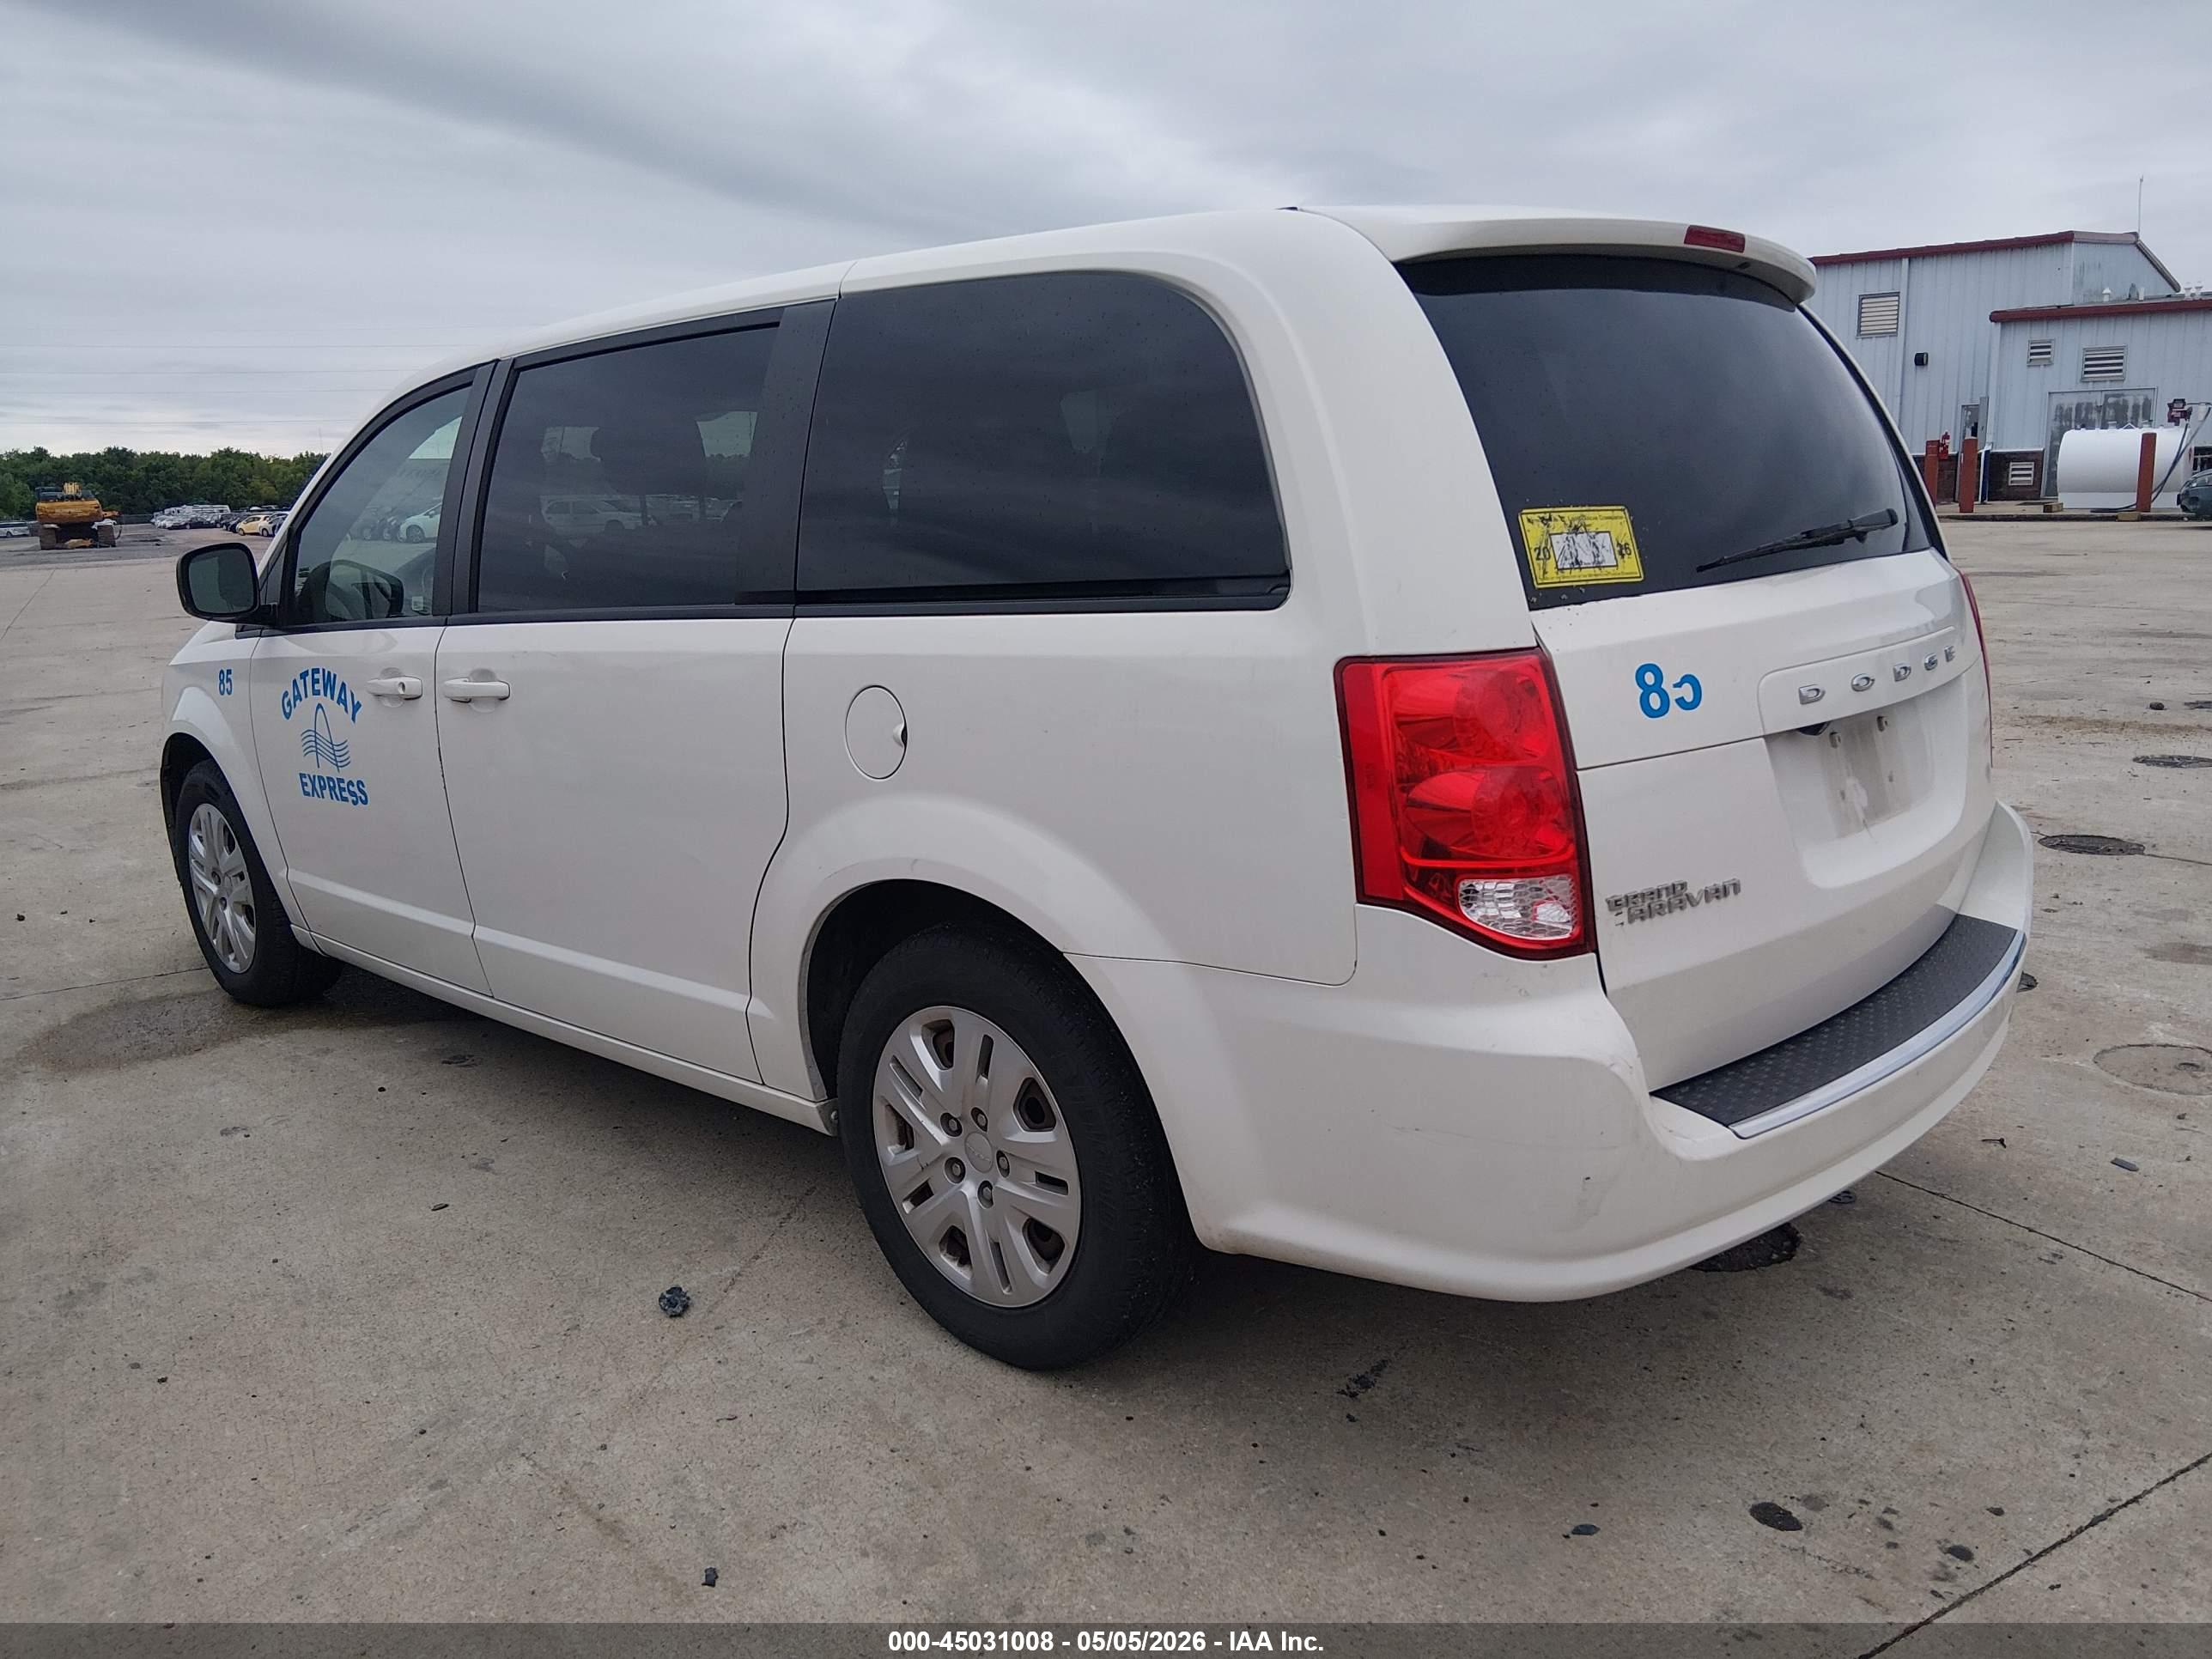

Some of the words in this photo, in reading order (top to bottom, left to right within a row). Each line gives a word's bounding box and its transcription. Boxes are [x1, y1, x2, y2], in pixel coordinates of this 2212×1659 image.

[218, 668, 234, 696] 85
[1798, 646, 1956, 705] DODGE
[282, 667, 362, 723] GATEWAY
[299, 773, 369, 806] EXPRESS
[1605, 879, 1688, 912] GRAND
